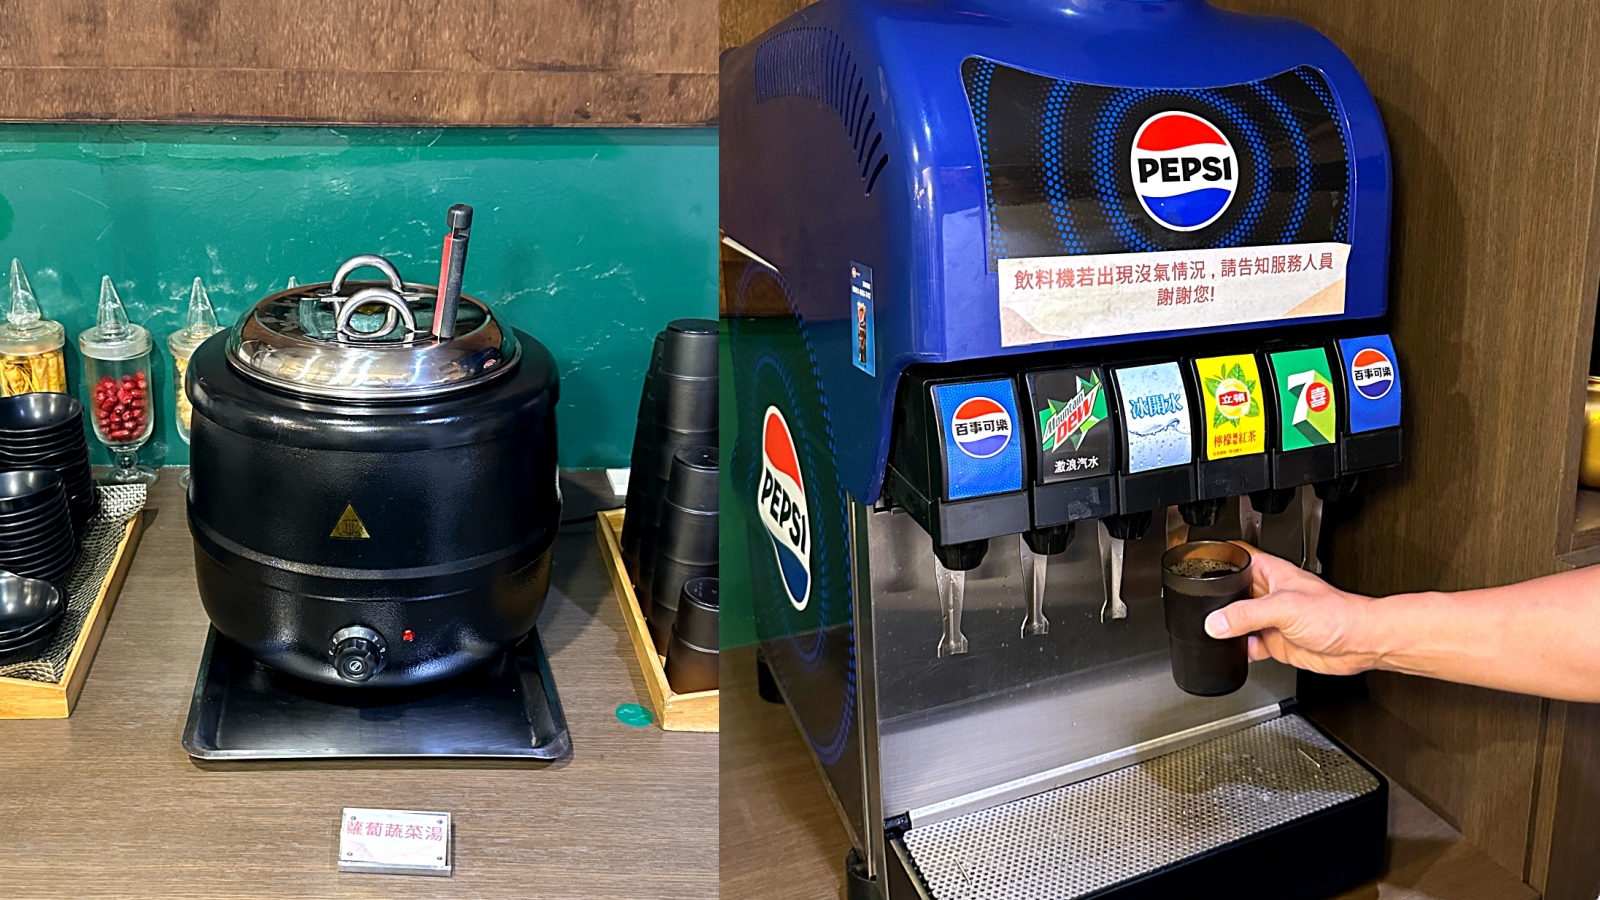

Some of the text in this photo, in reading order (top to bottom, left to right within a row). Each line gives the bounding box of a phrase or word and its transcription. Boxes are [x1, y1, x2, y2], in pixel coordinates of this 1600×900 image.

[1137, 156, 1232, 184] PEPSI
[1157, 286, 1215, 306] 謝謝您!
[1354, 366, 1392, 381] 百事可樂
[1128, 392, 1183, 419] 冰開水
[1221, 393, 1247, 405] 立頓
[1044, 392, 1084, 438] Mountain
[955, 418, 1009, 437] 百事可樂
[1054, 455, 1099, 474] 激浪汽水
[761, 466, 806, 556] PEPSI
[346, 820, 443, 841] 蘿蔔蔬菜湯
